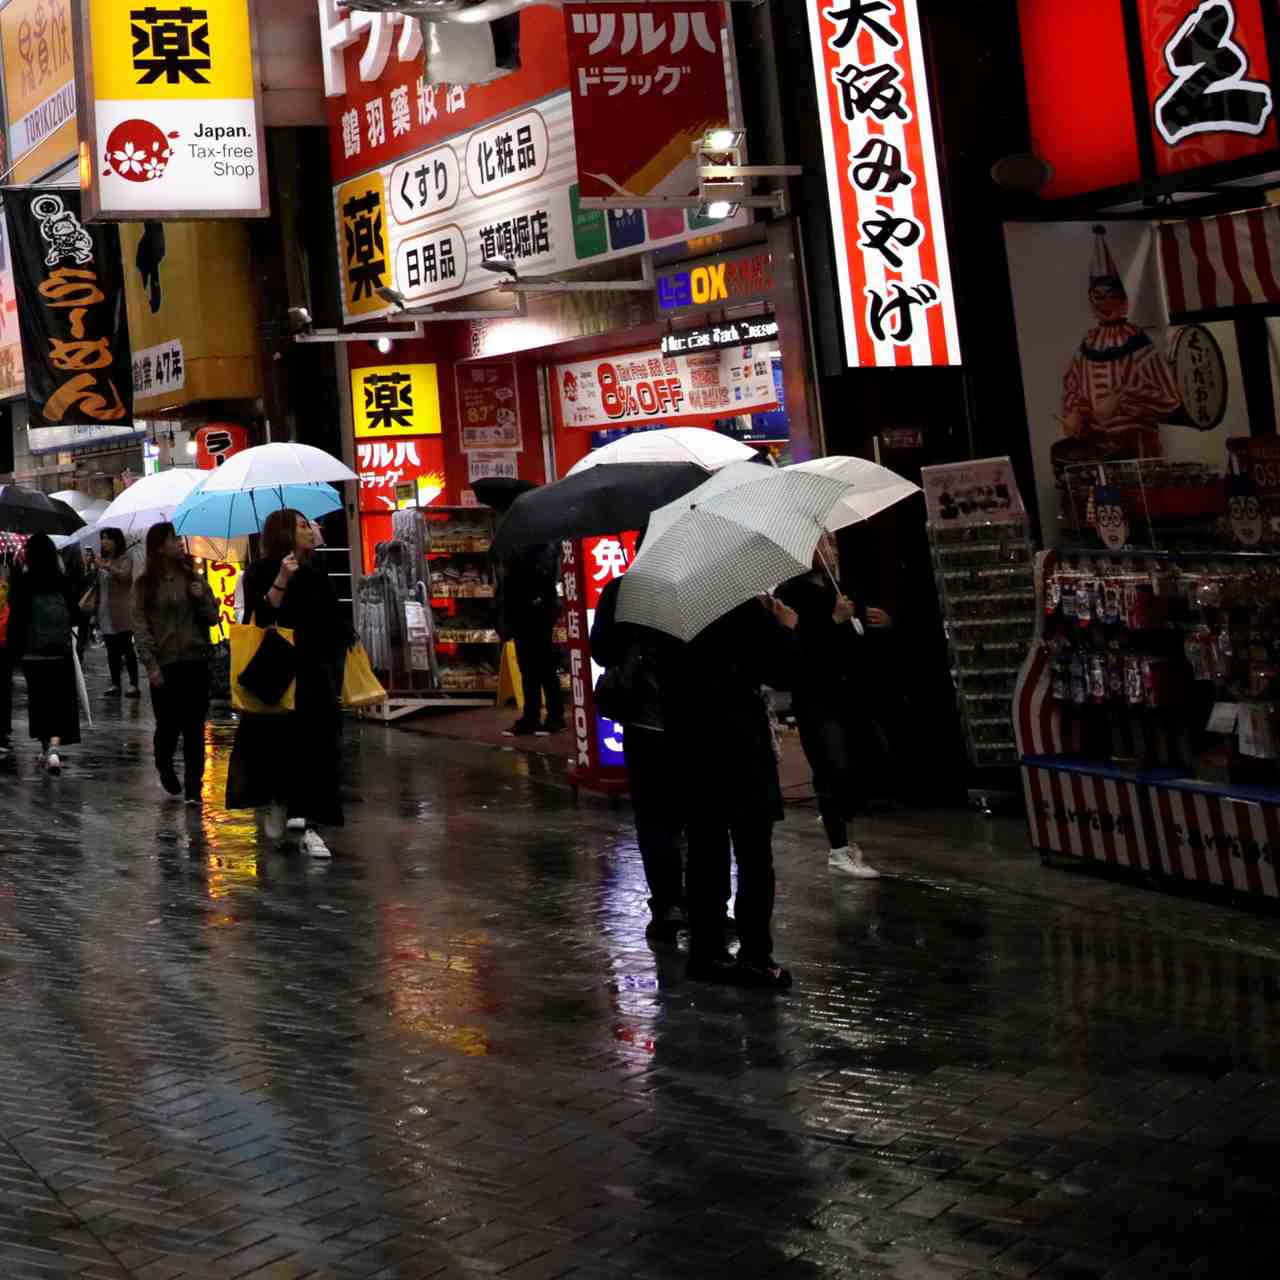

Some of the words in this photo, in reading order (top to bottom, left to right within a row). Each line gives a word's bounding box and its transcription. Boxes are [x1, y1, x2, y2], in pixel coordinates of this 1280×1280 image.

[130, 6, 211, 85] 薬
[571, 11, 717, 55] ツルハ
[578, 65, 693, 96] ドラッグ
[187, 143, 254, 159] Tax-free
[193, 122, 252, 140] Japan.
[476, 123, 536, 185] 化粧品
[213, 161, 255, 178] Shop
[398, 158, 449, 211] くすり
[343, 190, 385, 302] 薬
[479, 210, 551, 263] 道頓堀店
[404, 240, 457, 289] 日用品
[39, 267, 126, 421] らーめん
[363, 372, 414, 429] 薬
[357, 441, 421, 470] ツルハ
[590, 537, 630, 582] 免
[561, 538, 581, 641] 免税店
